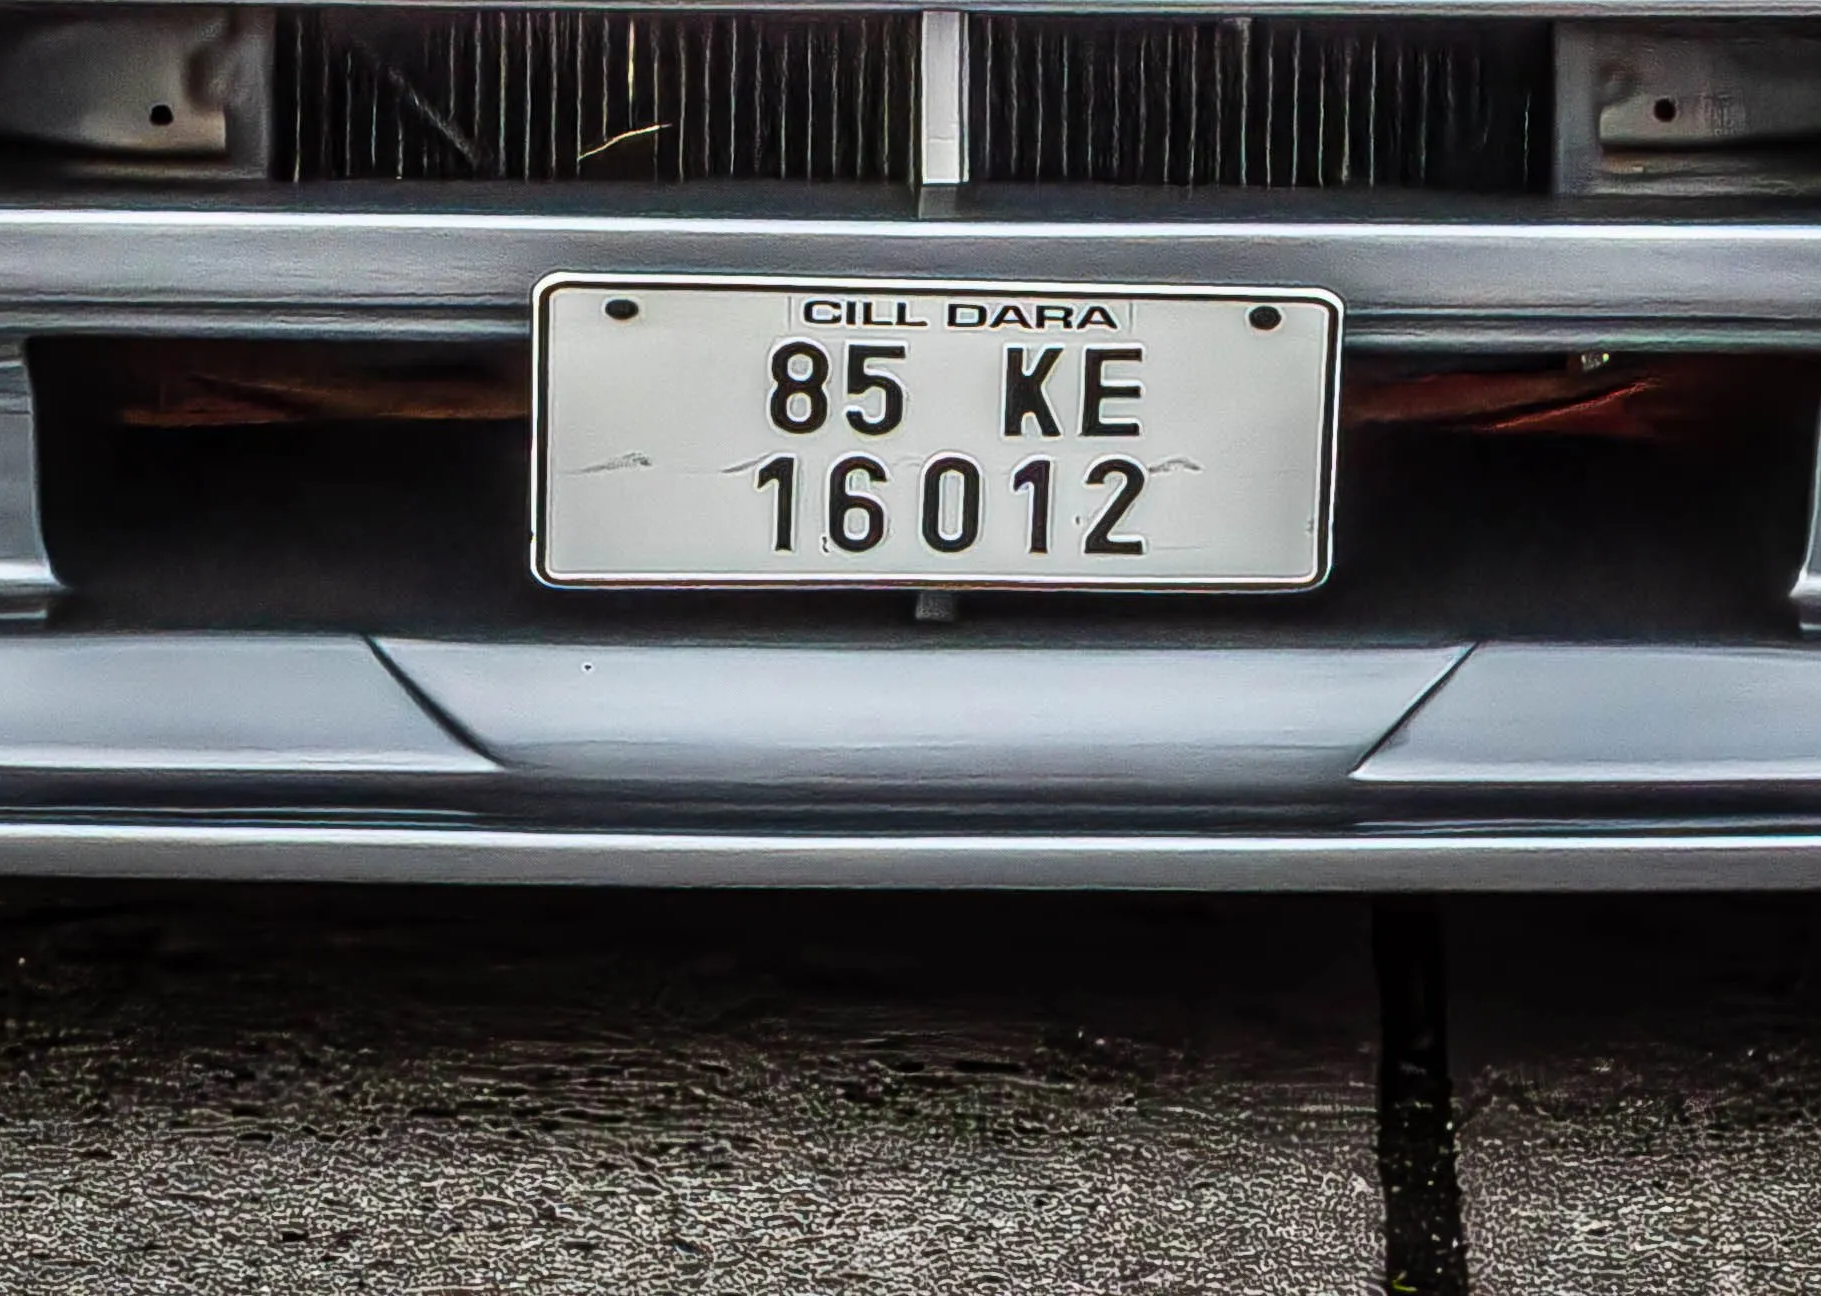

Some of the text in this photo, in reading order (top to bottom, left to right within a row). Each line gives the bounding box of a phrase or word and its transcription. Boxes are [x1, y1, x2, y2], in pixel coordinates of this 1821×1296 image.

[802, 298, 1120, 330] CILL DARA
[769, 340, 1144, 438] 85 KE
[756, 455, 1146, 557] 16012
